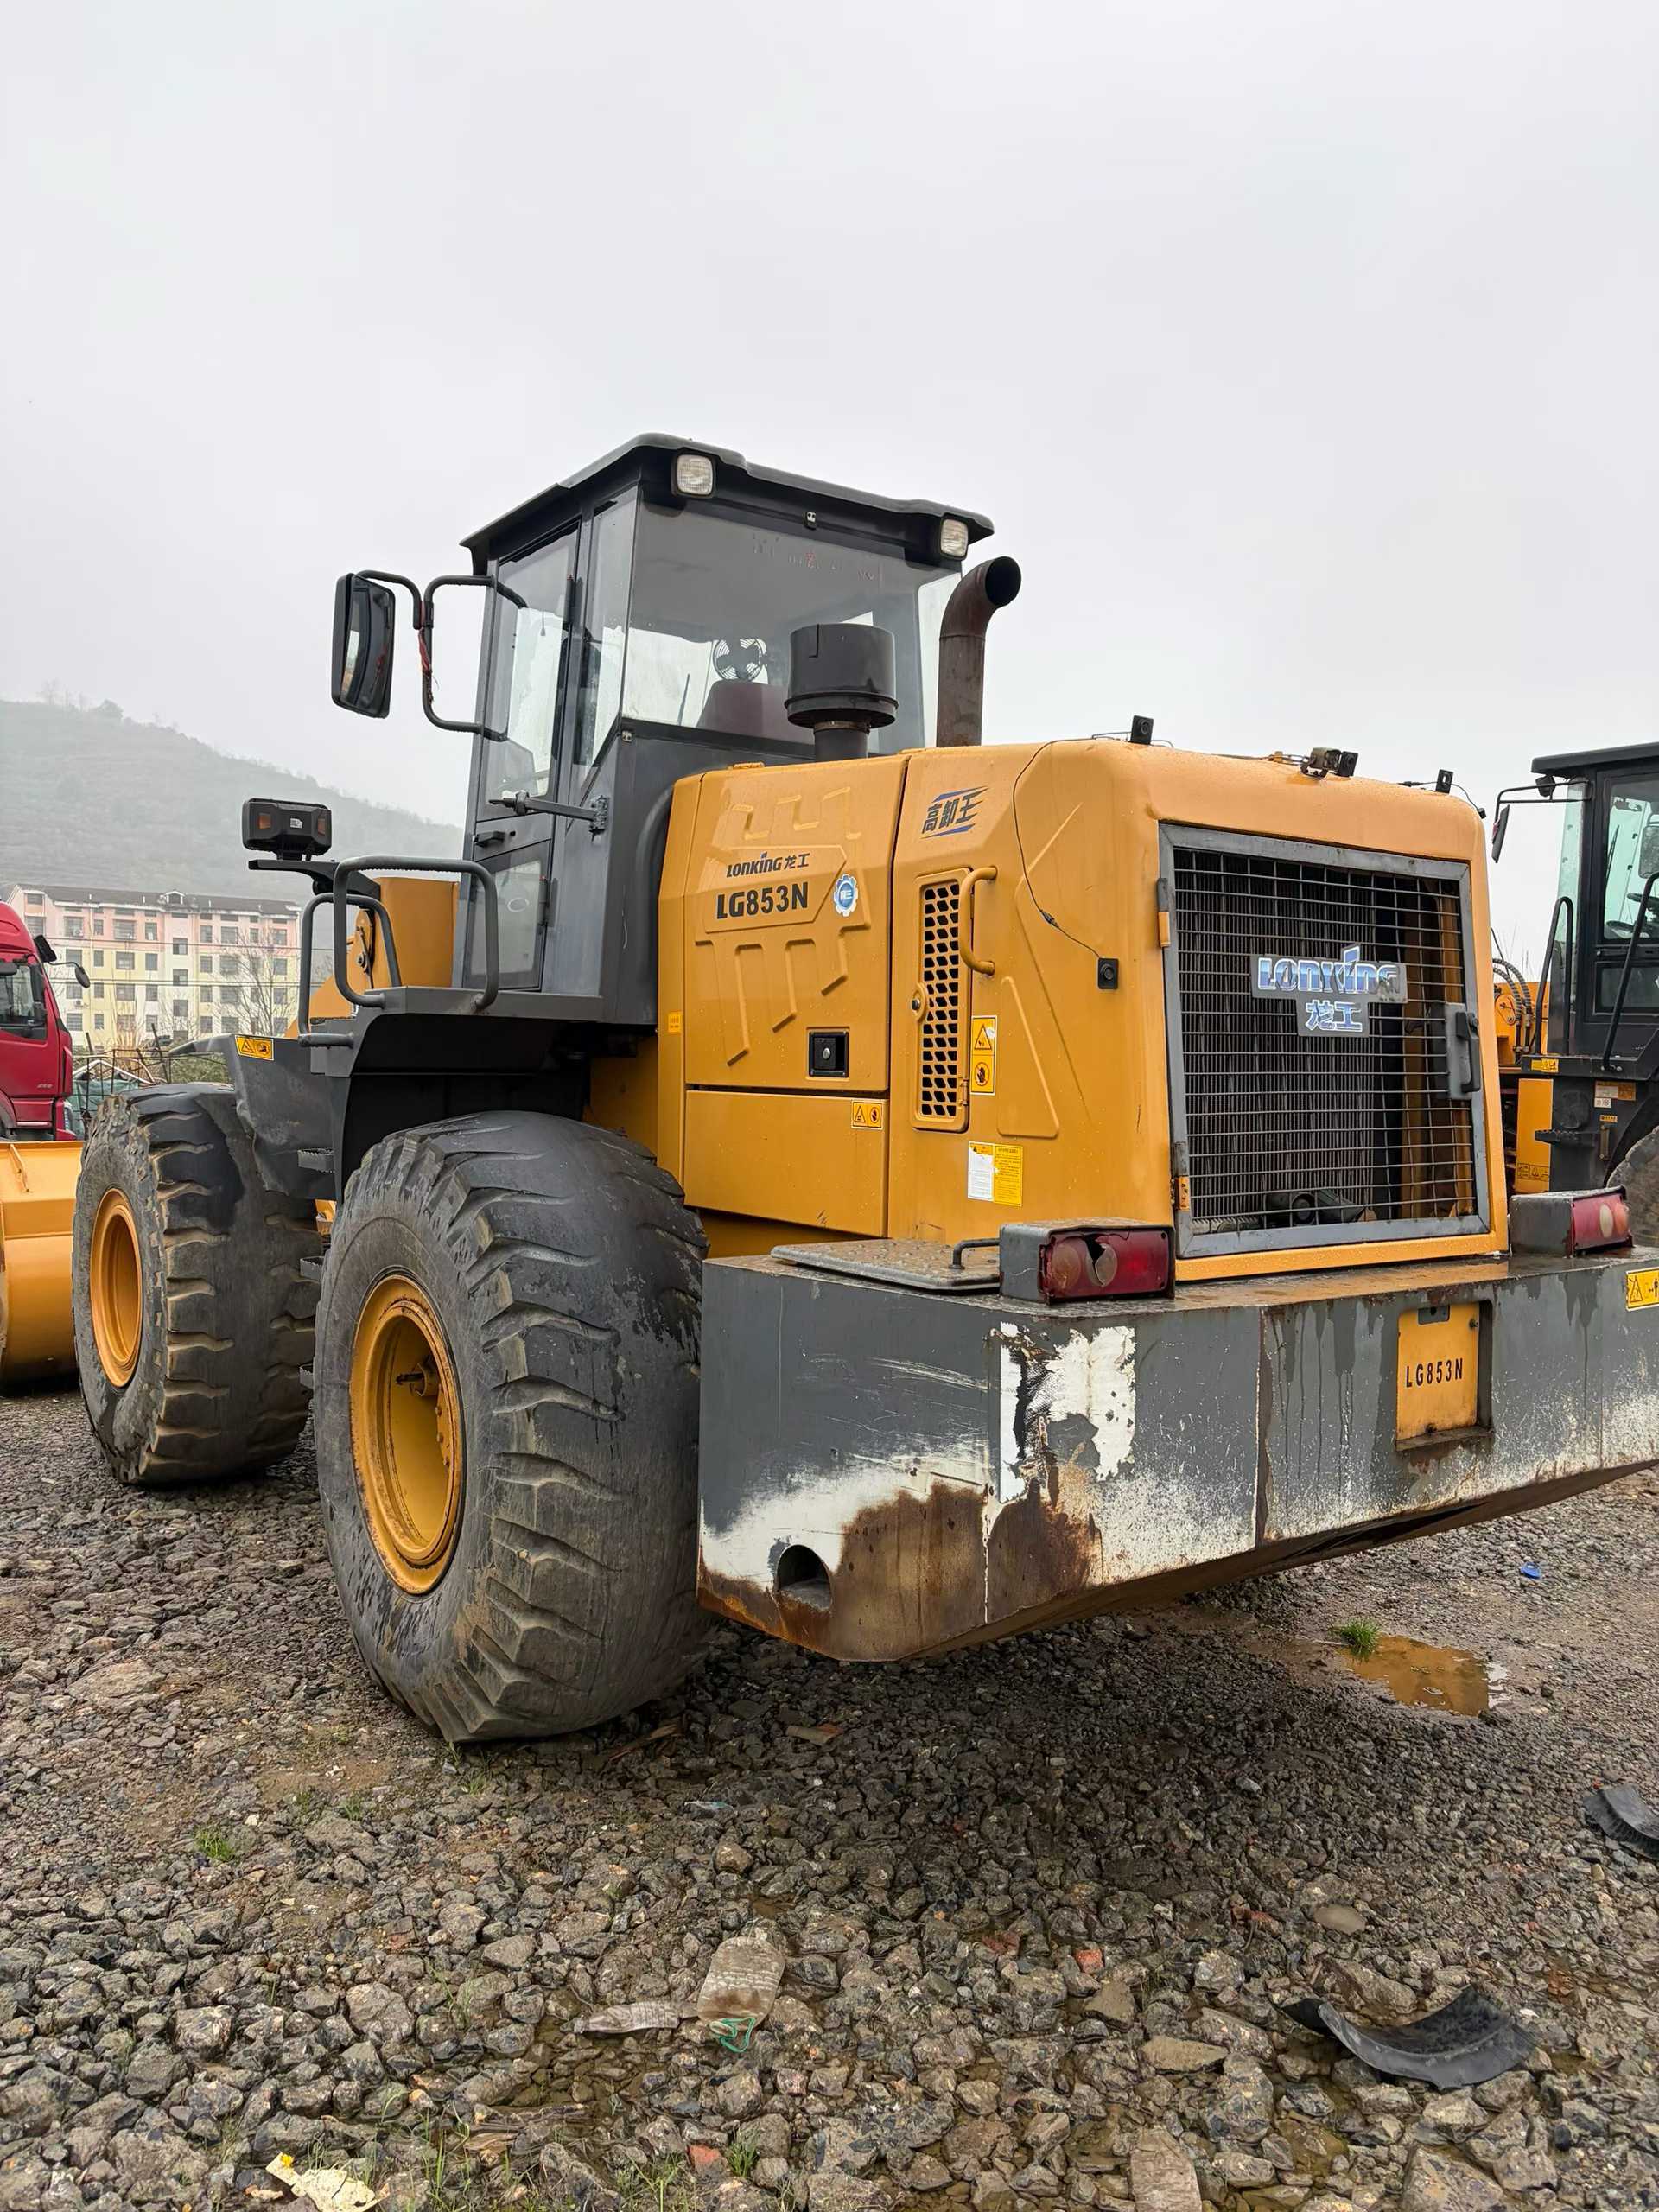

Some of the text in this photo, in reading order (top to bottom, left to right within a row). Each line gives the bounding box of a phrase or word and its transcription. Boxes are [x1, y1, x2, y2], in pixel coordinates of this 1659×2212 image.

[784, 853, 810, 870] 龙工
[716, 881, 809, 919] LG853N
[1406, 1357, 1463, 1388] LG853N
